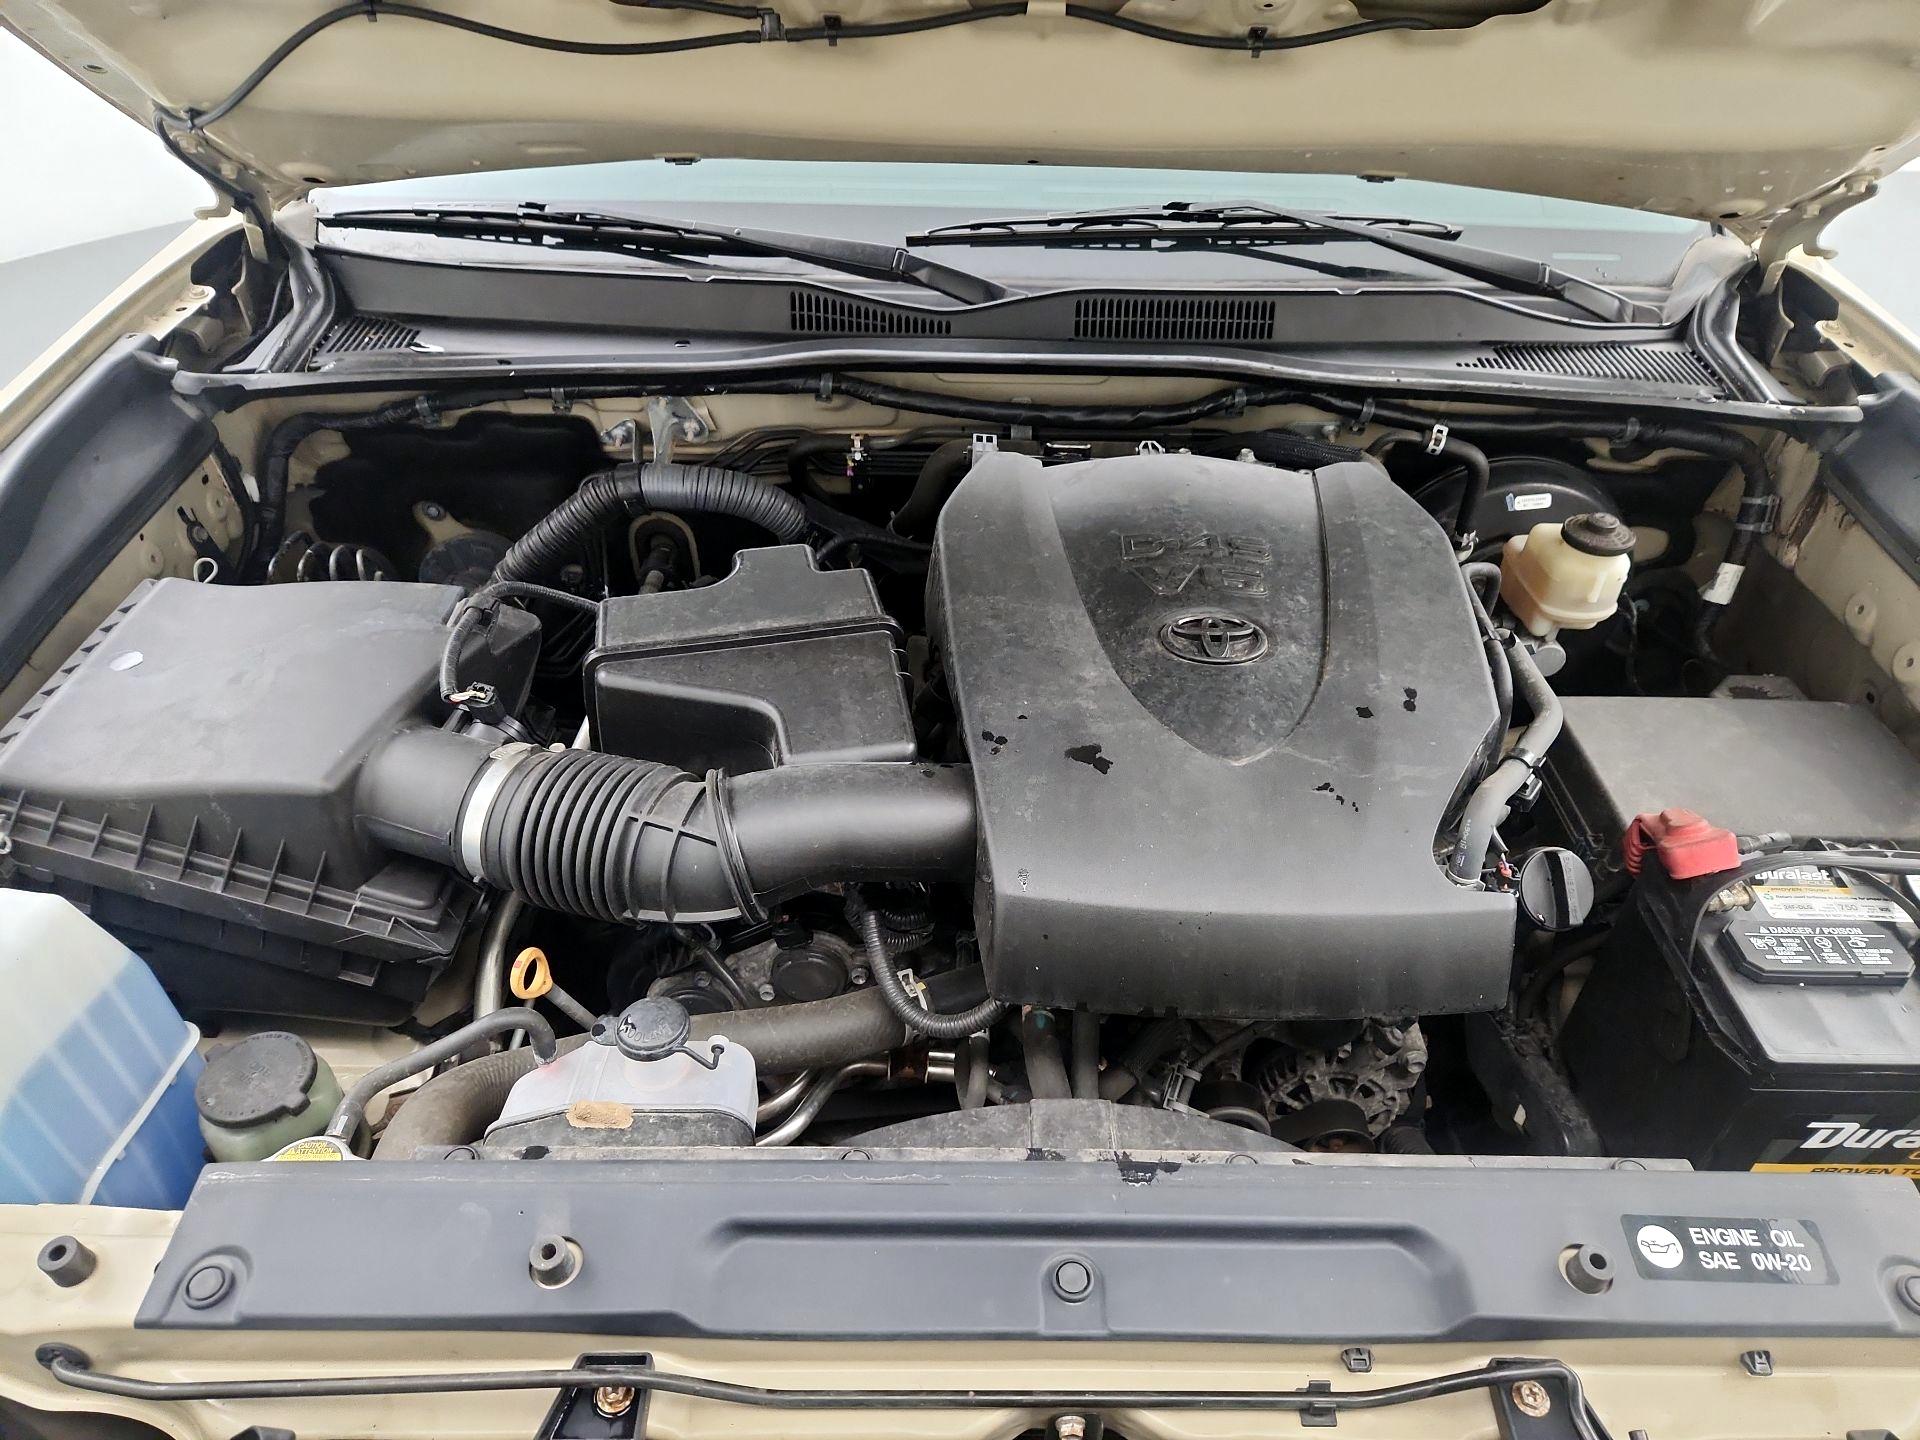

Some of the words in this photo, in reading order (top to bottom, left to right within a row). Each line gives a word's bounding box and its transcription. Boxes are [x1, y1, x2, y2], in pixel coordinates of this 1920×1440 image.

[1768, 927, 1815, 935] DANGER
[1822, 927, 1863, 935] POISON
[298, 1141, 328, 1149] CAUTION
[1688, 1227, 1761, 1247] ENGINE
[1770, 1229, 1804, 1248] OIL
[1698, 1251, 1741, 1270] SAE
[1750, 1252, 1812, 1272] 0W-20
